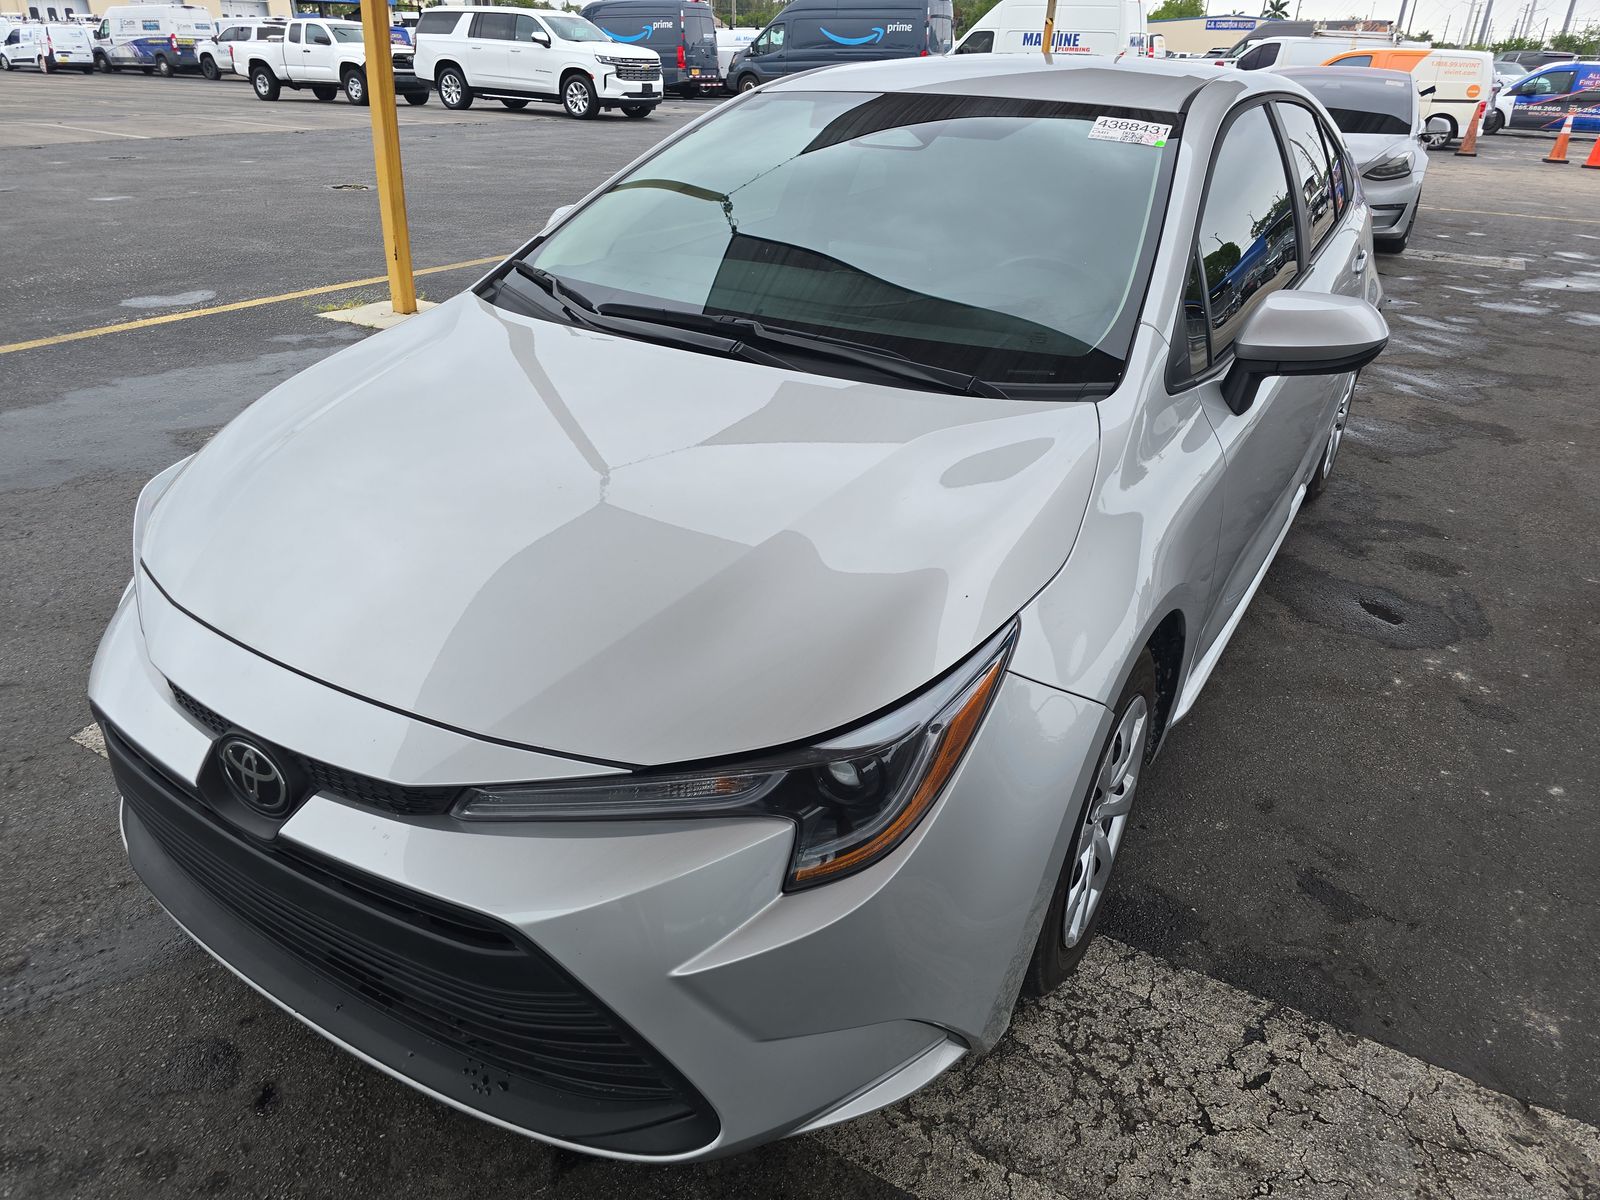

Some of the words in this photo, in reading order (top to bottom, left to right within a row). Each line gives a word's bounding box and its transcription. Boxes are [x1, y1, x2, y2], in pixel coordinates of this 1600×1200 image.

[653, 20, 673, 30] prime
[887, 22, 912, 33] prime
[1098, 119, 1168, 136] 4388431
